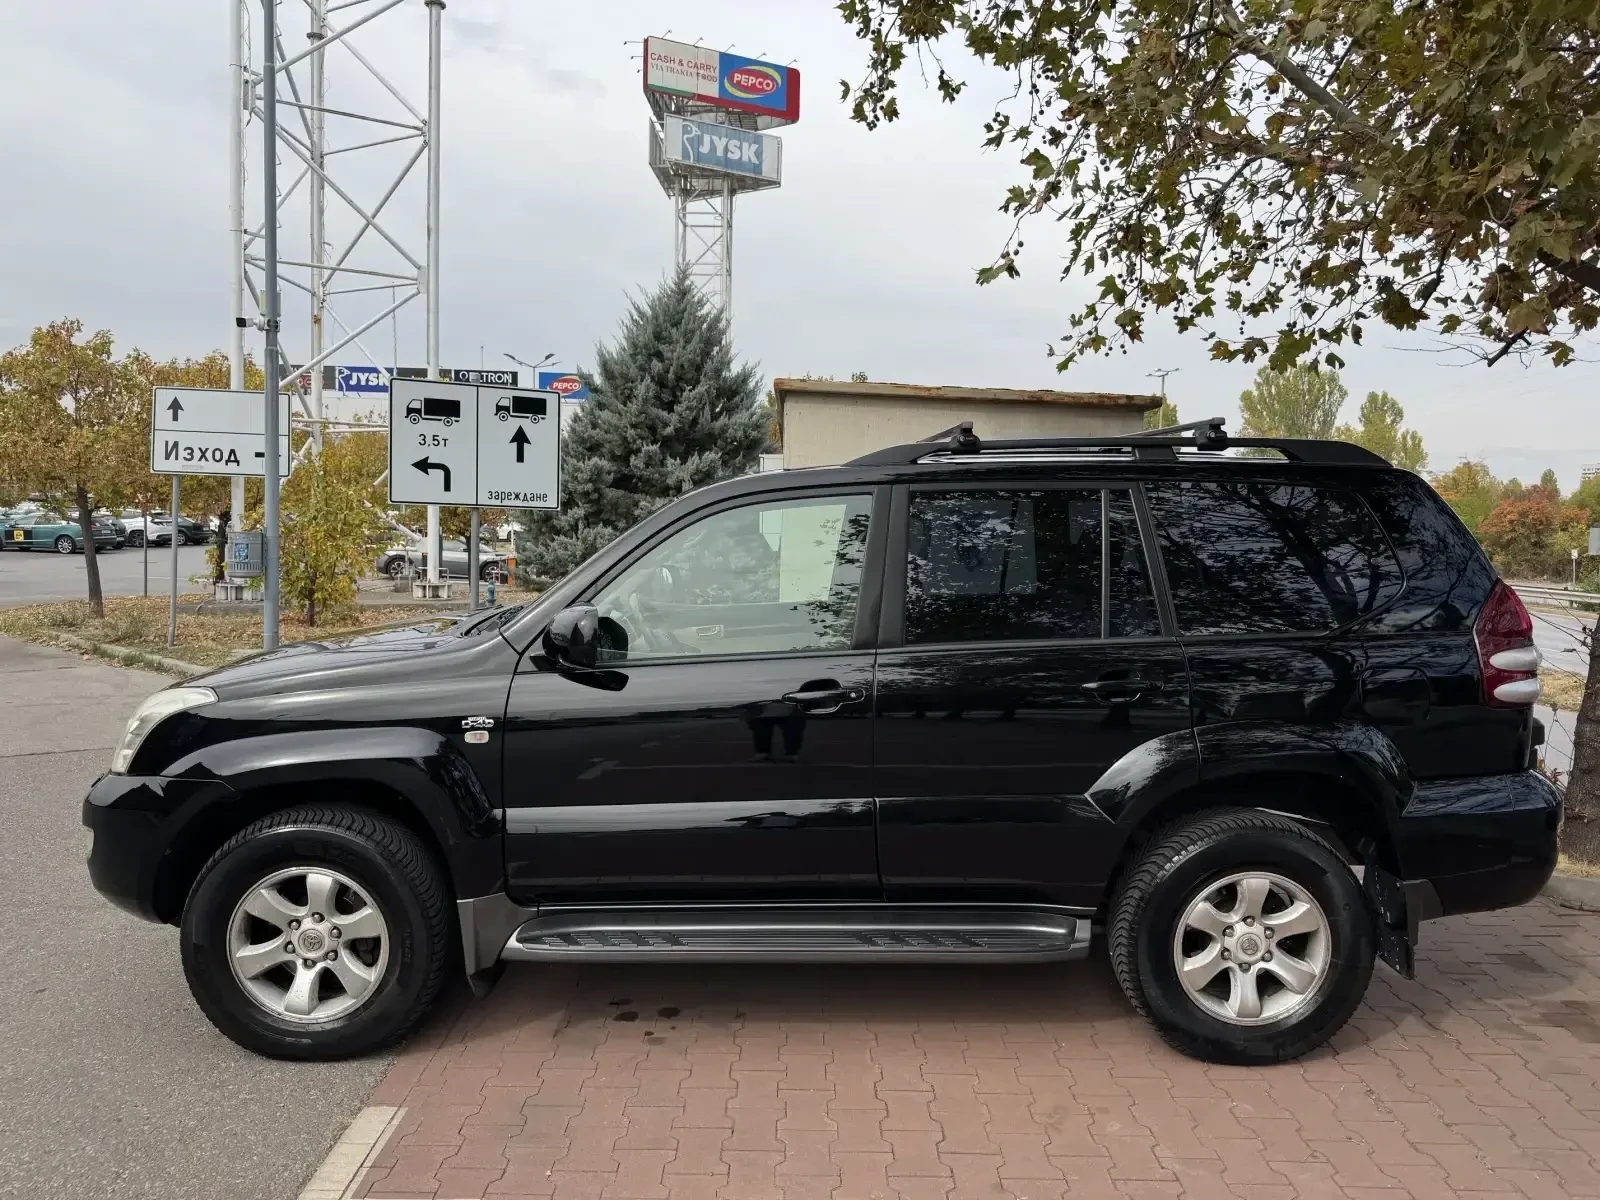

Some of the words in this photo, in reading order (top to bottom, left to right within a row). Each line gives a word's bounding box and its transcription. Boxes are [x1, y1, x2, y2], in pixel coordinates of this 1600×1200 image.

[650, 53, 675, 65] CASH
[678, 58, 685, 67] &
[687, 61, 718, 74] CARRY
[651, 62, 664, 72] VIA
[665, 66, 694, 78] TRAKIA
[733, 73, 773, 91] PEPCO
[698, 134, 760, 165] JYSK
[552, 382, 579, 390] PEPCO
[418, 433, 449, 447] 3,5т
[164, 440, 240, 467] Изход
[487, 490, 548, 503] зареждане
